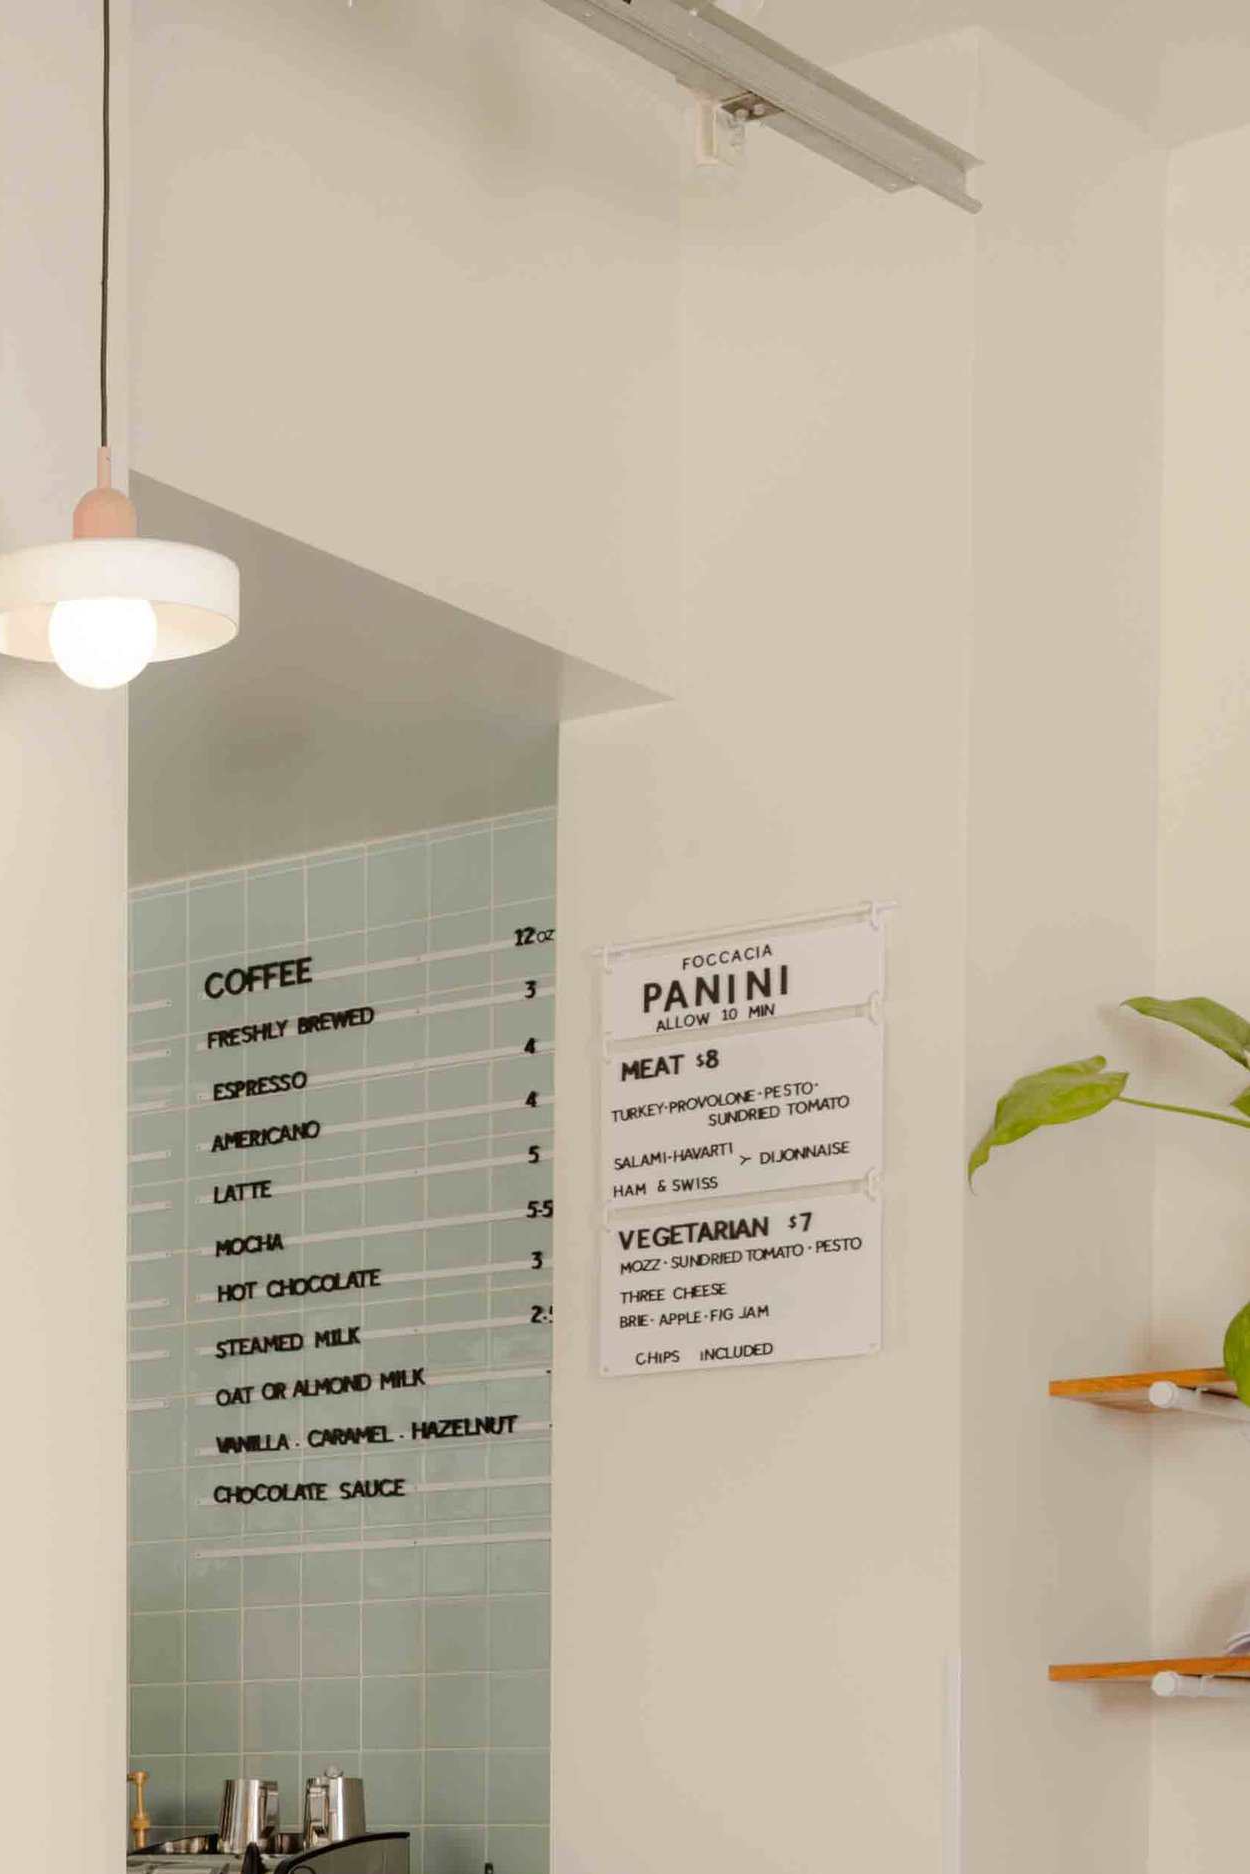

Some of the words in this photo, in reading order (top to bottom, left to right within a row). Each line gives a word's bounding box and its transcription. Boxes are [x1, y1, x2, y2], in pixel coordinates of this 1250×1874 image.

[680, 944, 773, 971] FOCCACIA
[204, 956, 313, 1000] COFFEE
[642, 964, 789, 1014] PANINI
[207, 1019, 289, 1050] FRESHLY
[297, 1006, 376, 1035] BREWED
[524, 979, 537, 1000] 3
[655, 1009, 711, 1033] ALLOW
[722, 1007, 738, 1022] 10
[748, 1003, 776, 1019] MIN
[213, 1070, 308, 1102] ESPRESSO
[523, 1037, 537, 1055] 4
[621, 1053, 685, 1082] MEAT
[696, 1048, 720, 1069] $8
[210, 1119, 321, 1153] AMERICANO
[524, 1090, 539, 1108] 4
[706, 1101, 781, 1127] SUNDRIED
[784, 1092, 850, 1116] TOMATO
[759, 1140, 850, 1166] DIJONNAISE
[213, 1179, 273, 1205] LATTE
[528, 1144, 541, 1164] 5
[613, 1182, 647, 1198] HAM
[657, 1179, 667, 1193] &
[671, 1175, 719, 1192] SWISS
[215, 1233, 285, 1258] MOCHA
[618, 1216, 770, 1251] VEGETARIAN
[788, 1211, 813, 1233] $7
[620, 1258, 662, 1275] MOZZ
[670, 1250, 744, 1270] SUNDRIED
[745, 1243, 805, 1262] TOMATO
[815, 1236, 863, 1254] PESTO
[217, 1280, 259, 1303] HOT
[266, 1268, 382, 1299] CHOCOLATE
[531, 1250, 543, 1270] 3
[619, 1288, 665, 1304] THREE
[672, 1282, 727, 1300] CHEESE
[658, 1310, 702, 1327] APPLE
[710, 1307, 735, 1323] FIG
[738, 1304, 770, 1320] JAM
[214, 1332, 304, 1360] STEAMED
[314, 1326, 362, 1349] MILK
[635, 1349, 681, 1366] CHIPS
[700, 1342, 774, 1362] INCLUDED
[215, 1385, 255, 1407] OAT
[260, 1381, 288, 1401] OR
[292, 1372, 373, 1398] ALMOND
[379, 1367, 426, 1391] MILK
[215, 1432, 290, 1454] VANILLA
[306, 1424, 395, 1449] CARAMEL
[411, 1414, 519, 1440] HAZELNUT
[213, 1482, 328, 1505] CHOCOLATE
[338, 1478, 406, 1500] SAUCE
